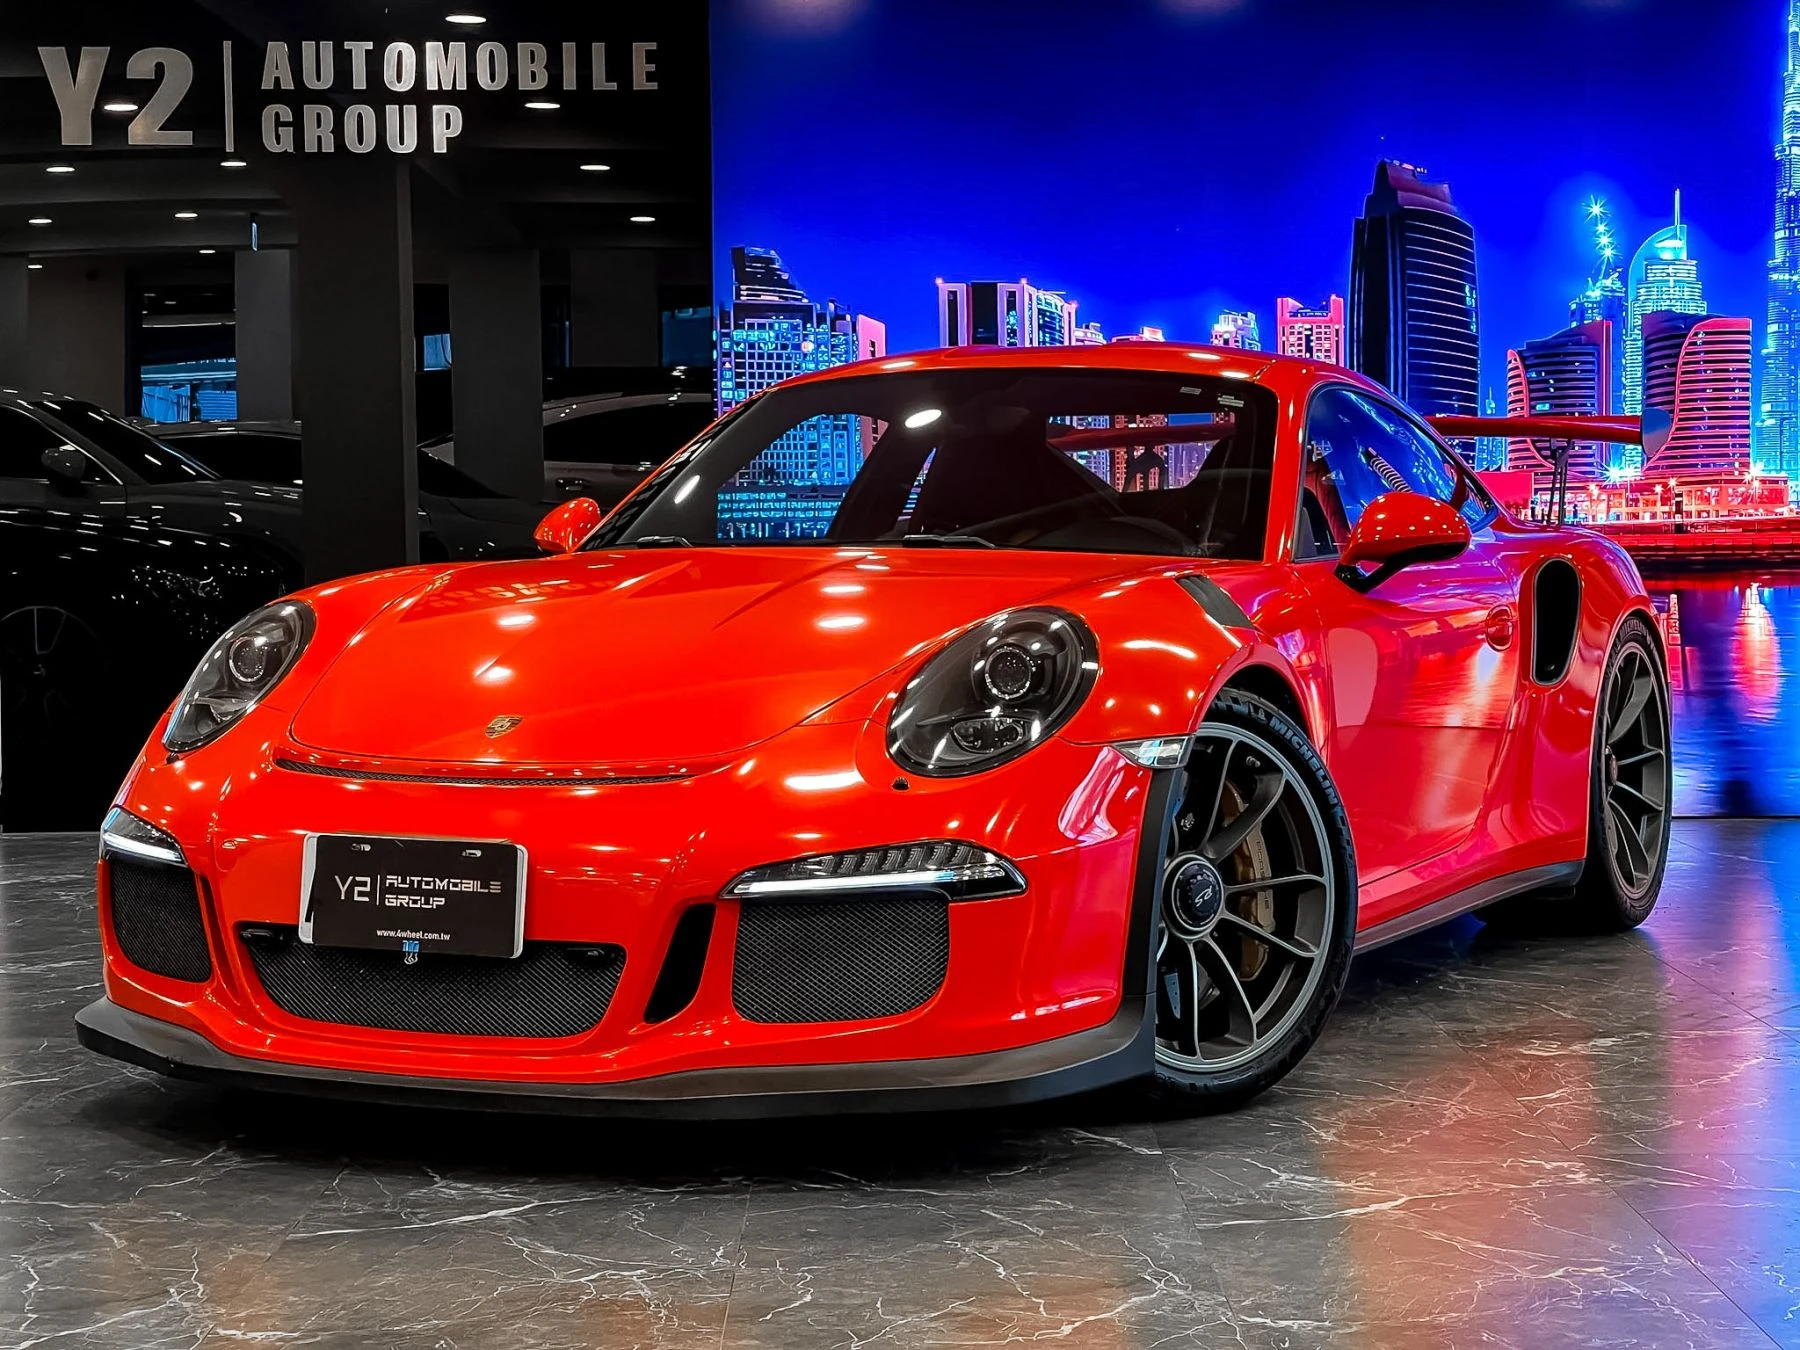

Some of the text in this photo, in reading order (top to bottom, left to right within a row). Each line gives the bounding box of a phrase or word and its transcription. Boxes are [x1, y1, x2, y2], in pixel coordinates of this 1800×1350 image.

[261, 41, 658, 91] AUTOMOBILE
[38, 47, 194, 146] Y2
[262, 104, 463, 153] GROUP
[1269, 716, 1339, 806] MICHELIN
[335, 875, 371, 902] Y2
[385, 875, 501, 893] AUTOMOBILE
[385, 895, 446, 909] GROUP
[377, 929, 451, 942] www.4wheel.com.tw
